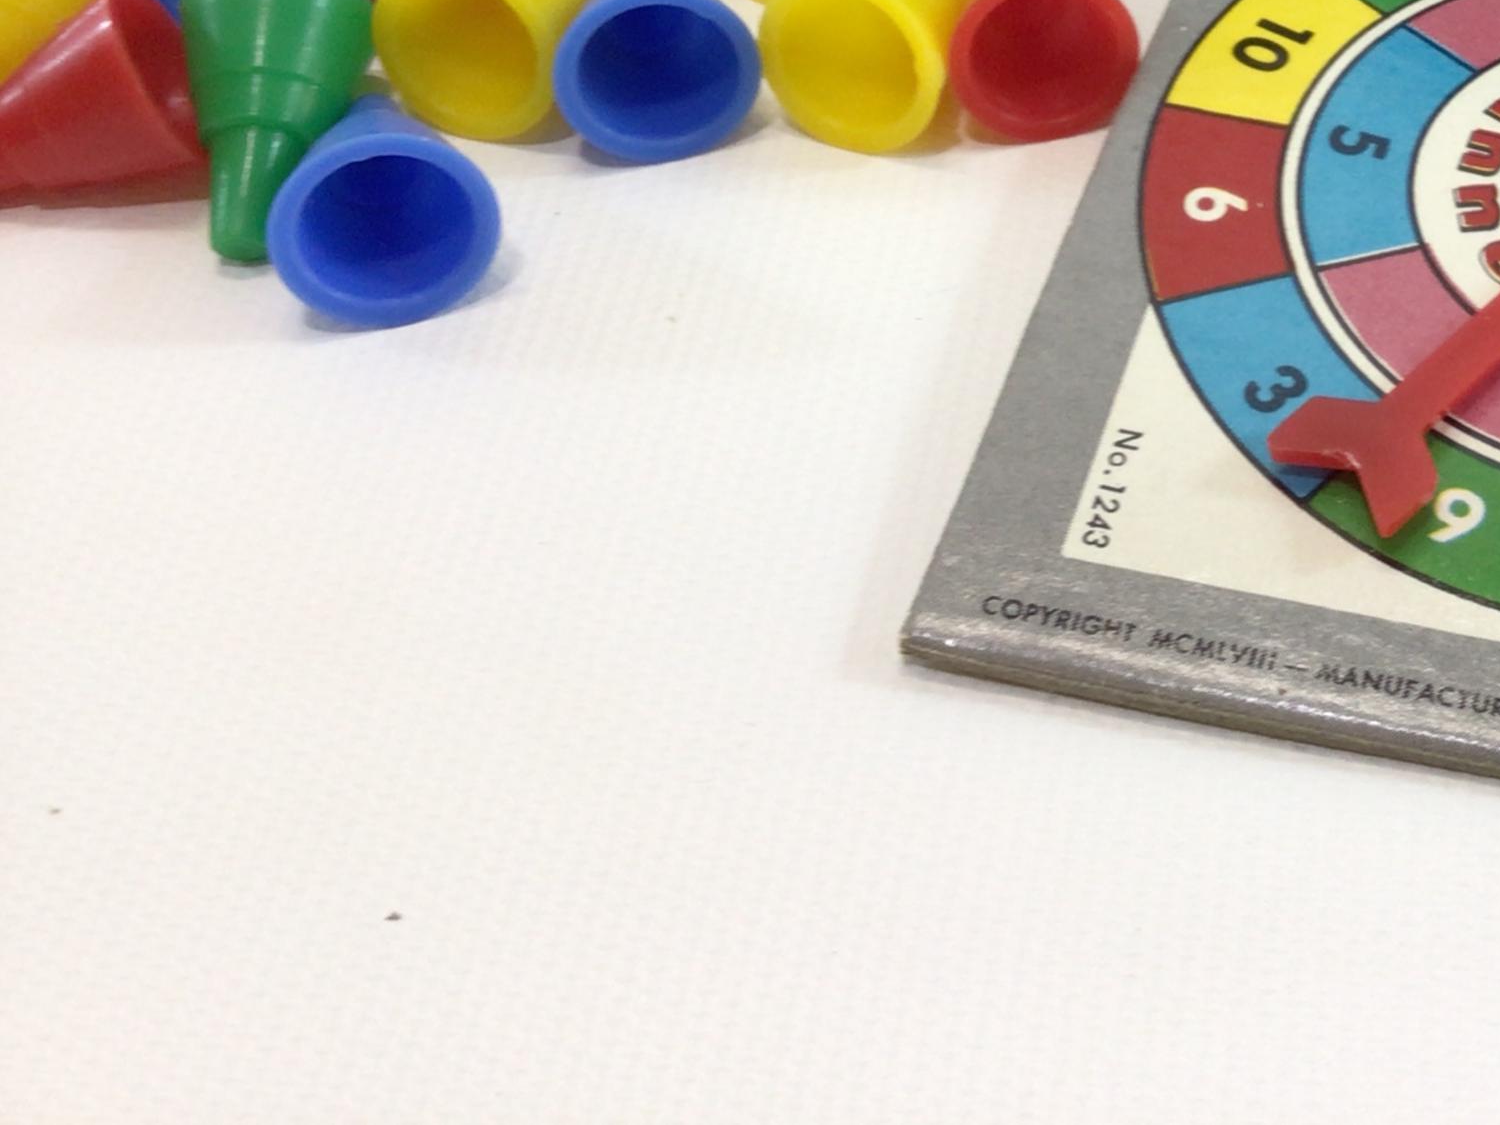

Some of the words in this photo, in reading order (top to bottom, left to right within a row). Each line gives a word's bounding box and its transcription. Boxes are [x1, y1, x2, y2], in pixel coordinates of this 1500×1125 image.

[1231, 18, 1316, 72] 10
[1328, 124, 1392, 161] 5
[1244, 365, 1309, 414] 3
[982, 595, 1137, 642] COPYRIGHT
